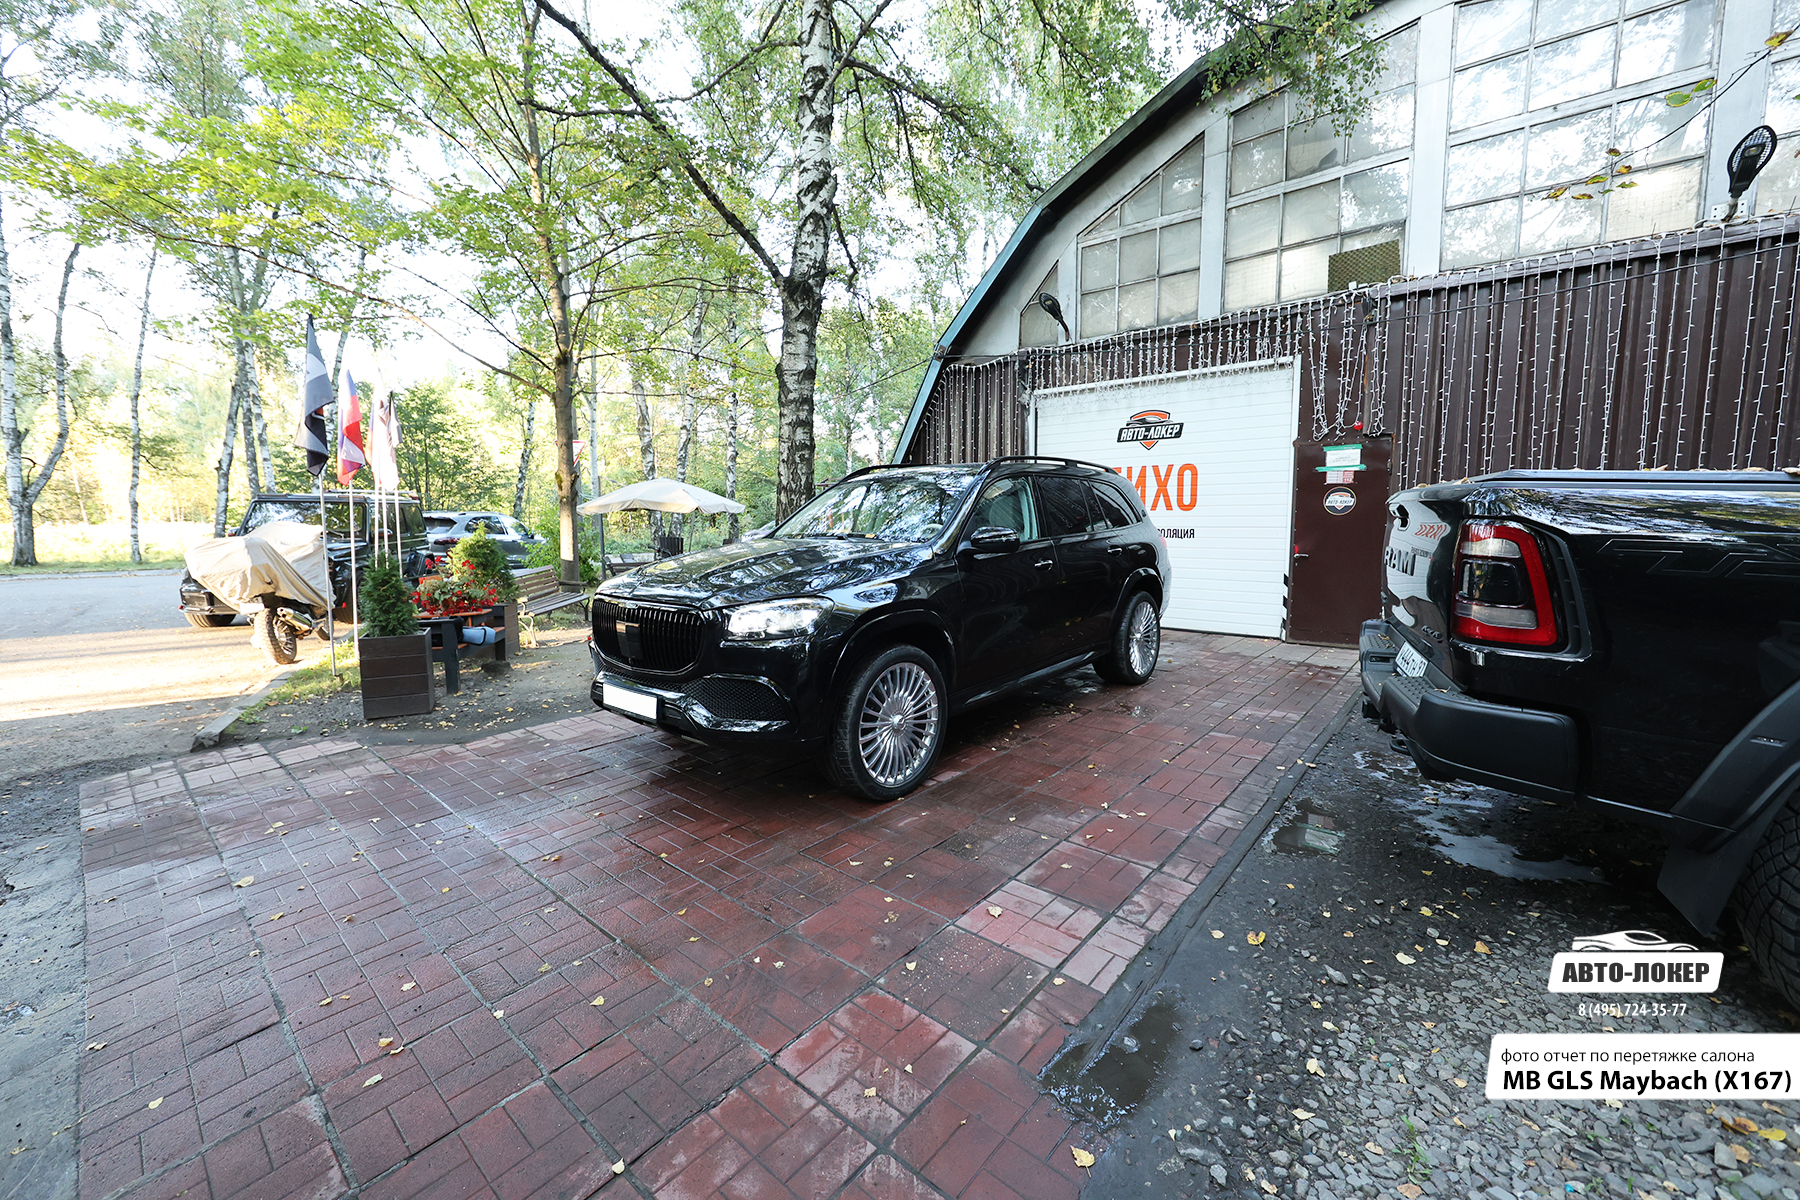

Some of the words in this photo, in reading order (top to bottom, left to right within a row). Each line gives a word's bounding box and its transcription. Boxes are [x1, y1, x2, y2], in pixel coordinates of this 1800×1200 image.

[1120, 424, 1181, 442] АВТО-ЛОКЕР
[1104, 463, 1198, 511] ИХО
[1157, 528, 1195, 540] ОЛЯЦИЯ
[1384, 546, 1416, 577] RAM
